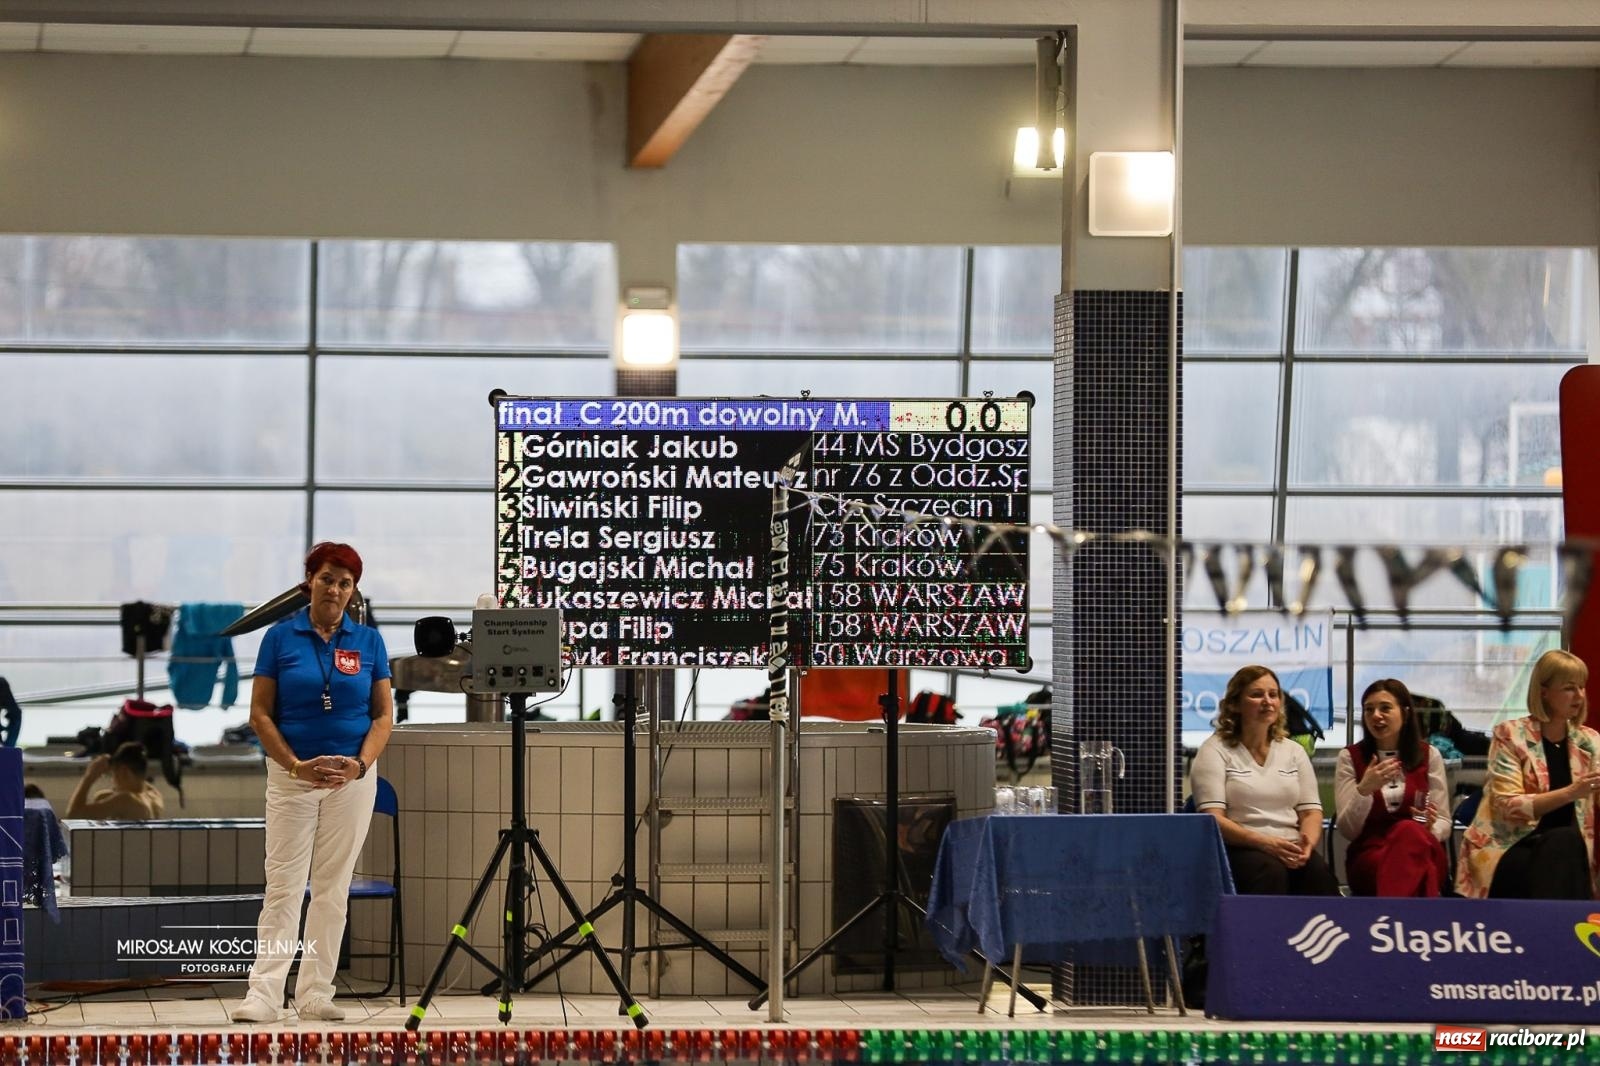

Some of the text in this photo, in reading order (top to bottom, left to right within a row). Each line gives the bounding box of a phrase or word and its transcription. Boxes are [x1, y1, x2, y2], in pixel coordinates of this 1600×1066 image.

[498, 401, 867, 430] finał C 200m dowolny M.
[945, 401, 1001, 431] 0.0
[523, 432, 638, 459] Górniak
[647, 434, 738, 459] Jakub
[814, 433, 1027, 462] 44 MS Bydgosz
[501, 462, 808, 491] 2 Gawroński Mateuz
[814, 467, 841, 487] nr
[850, 463, 881, 487] 76
[890, 469, 903, 487] z
[500, 489, 702, 525] 3 Śliwiński Filip
[874, 493, 993, 517] Szczecin
[1007, 494, 1014, 517] 1
[500, 522, 716, 554] 4 Trela Sergiusz
[814, 522, 962, 547] 75 Kraków
[500, 553, 754, 584] 5 Bugajski Michał
[814, 553, 962, 577] 75 Kraków
[519, 584, 704, 609] Łukaszewicz
[814, 583, 1026, 607] 158 WARSZAW
[484, 619, 547, 628] Championship
[513, 628, 544, 637] System
[619, 615, 673, 644] Filip
[814, 613, 1026, 637] 158 WARSZAW
[617, 646, 769, 665] Franciszek
[812, 643, 845, 665] 50
[1369, 915, 1525, 962] Śląskie.
